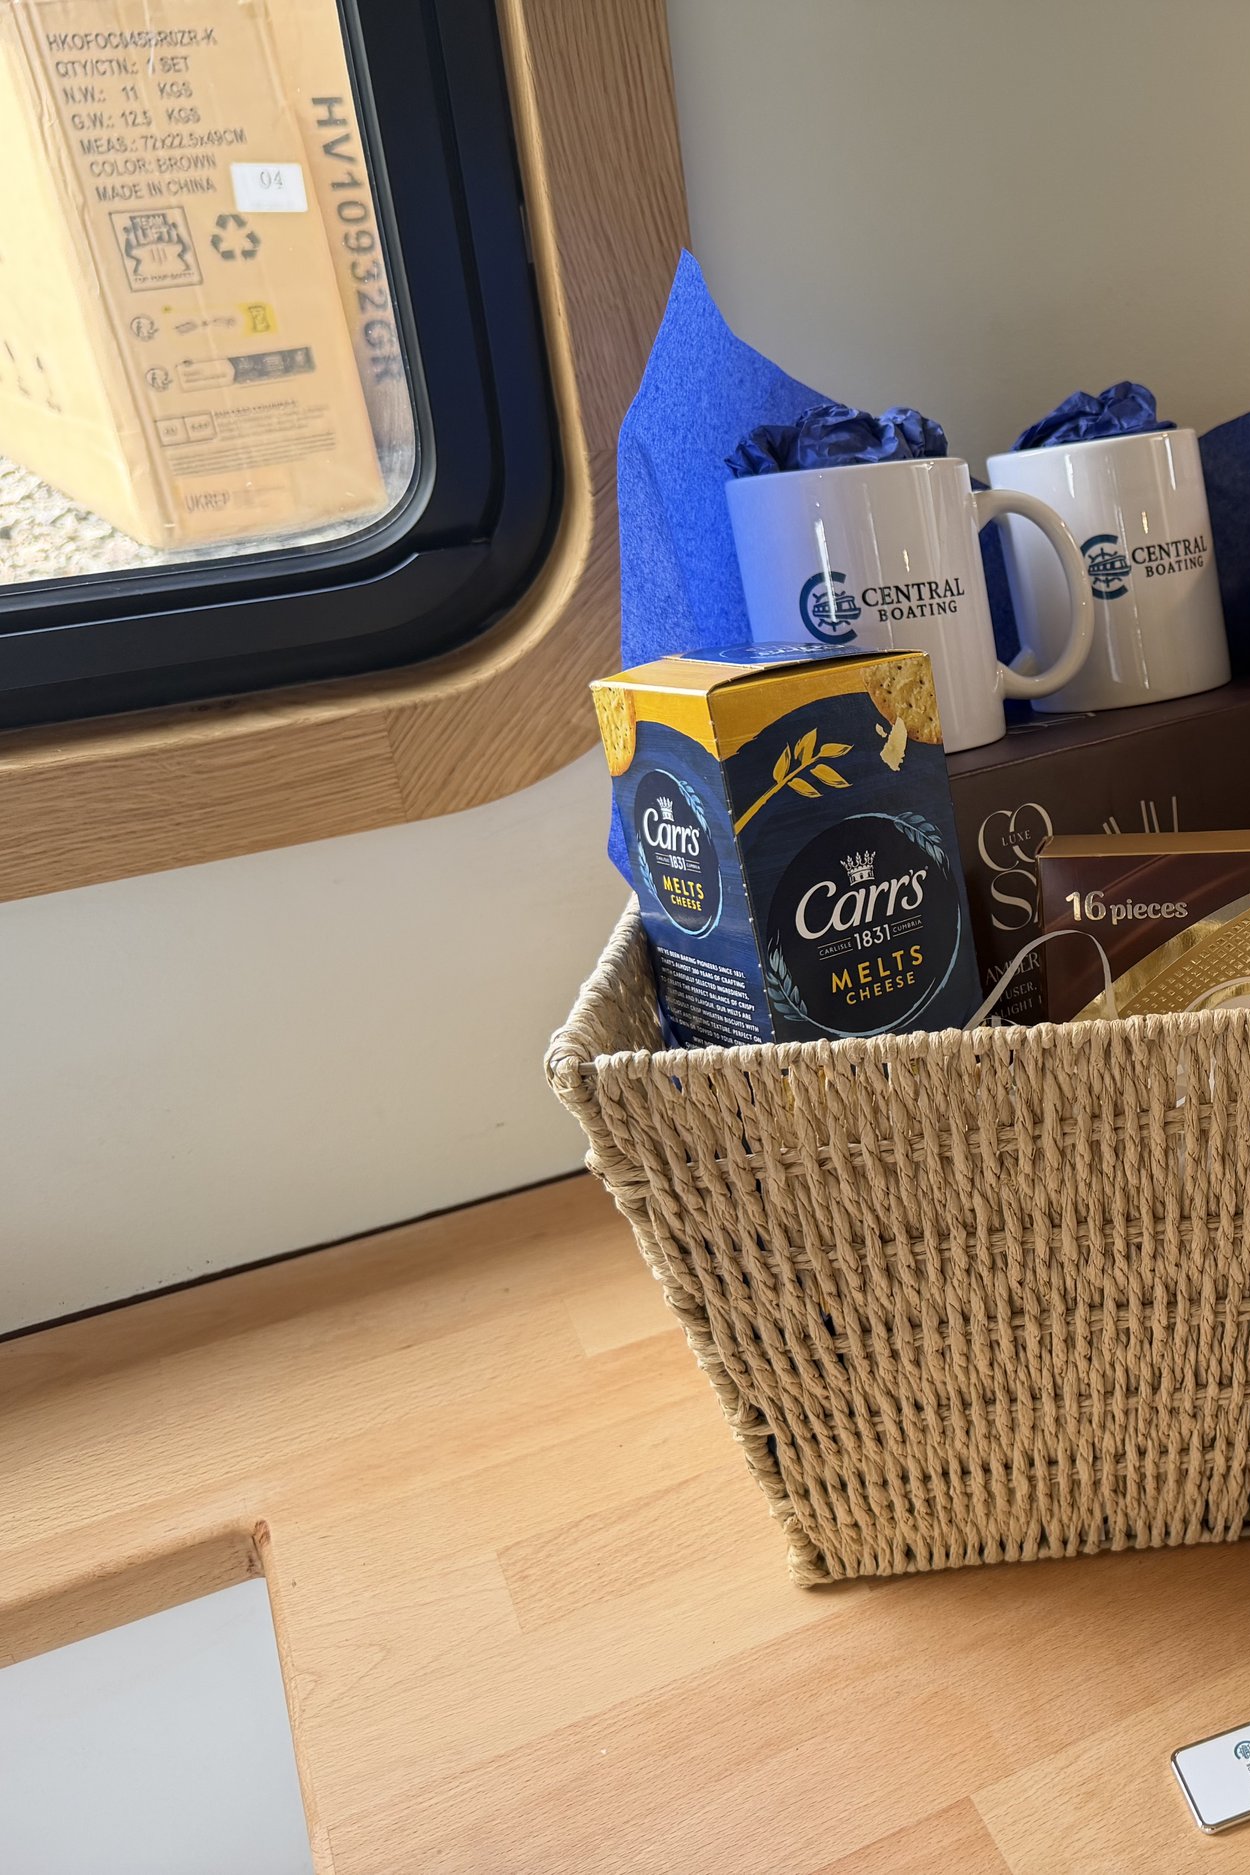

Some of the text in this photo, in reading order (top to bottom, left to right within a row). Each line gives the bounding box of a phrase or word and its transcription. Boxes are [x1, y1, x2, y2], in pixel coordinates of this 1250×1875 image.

[160, 55, 190, 73] SET
[121, 85, 139, 101] 11
[158, 81, 193, 99] KGS
[120, 111, 152, 128] 12.5
[166, 109, 201, 125] KGS
[157, 154, 217, 175] BROWN
[95, 177, 217, 201] MADE IN CHINA
[259, 170, 285, 190] 04
[1131, 535, 1208, 565] CENTRAL
[1145, 555, 1204, 578] BOATING
[861, 577, 965, 607] CENTRAL
[877, 599, 958, 623] BOATING
[643, 808, 700, 856] Carr's
[1001, 829, 1032, 847] LUXE
[669, 854, 687, 871] 1831
[663, 874, 705, 900] MELTS
[670, 894, 702, 912] CHEESE
[795, 868, 927, 940] Carr's
[1065, 889, 1188, 926] 16 pieces
[819, 918, 922, 957] CARLISLE 1831 CUMBRIA
[831, 945, 924, 993] MELTS
[846, 971, 916, 1005] CHEESE
